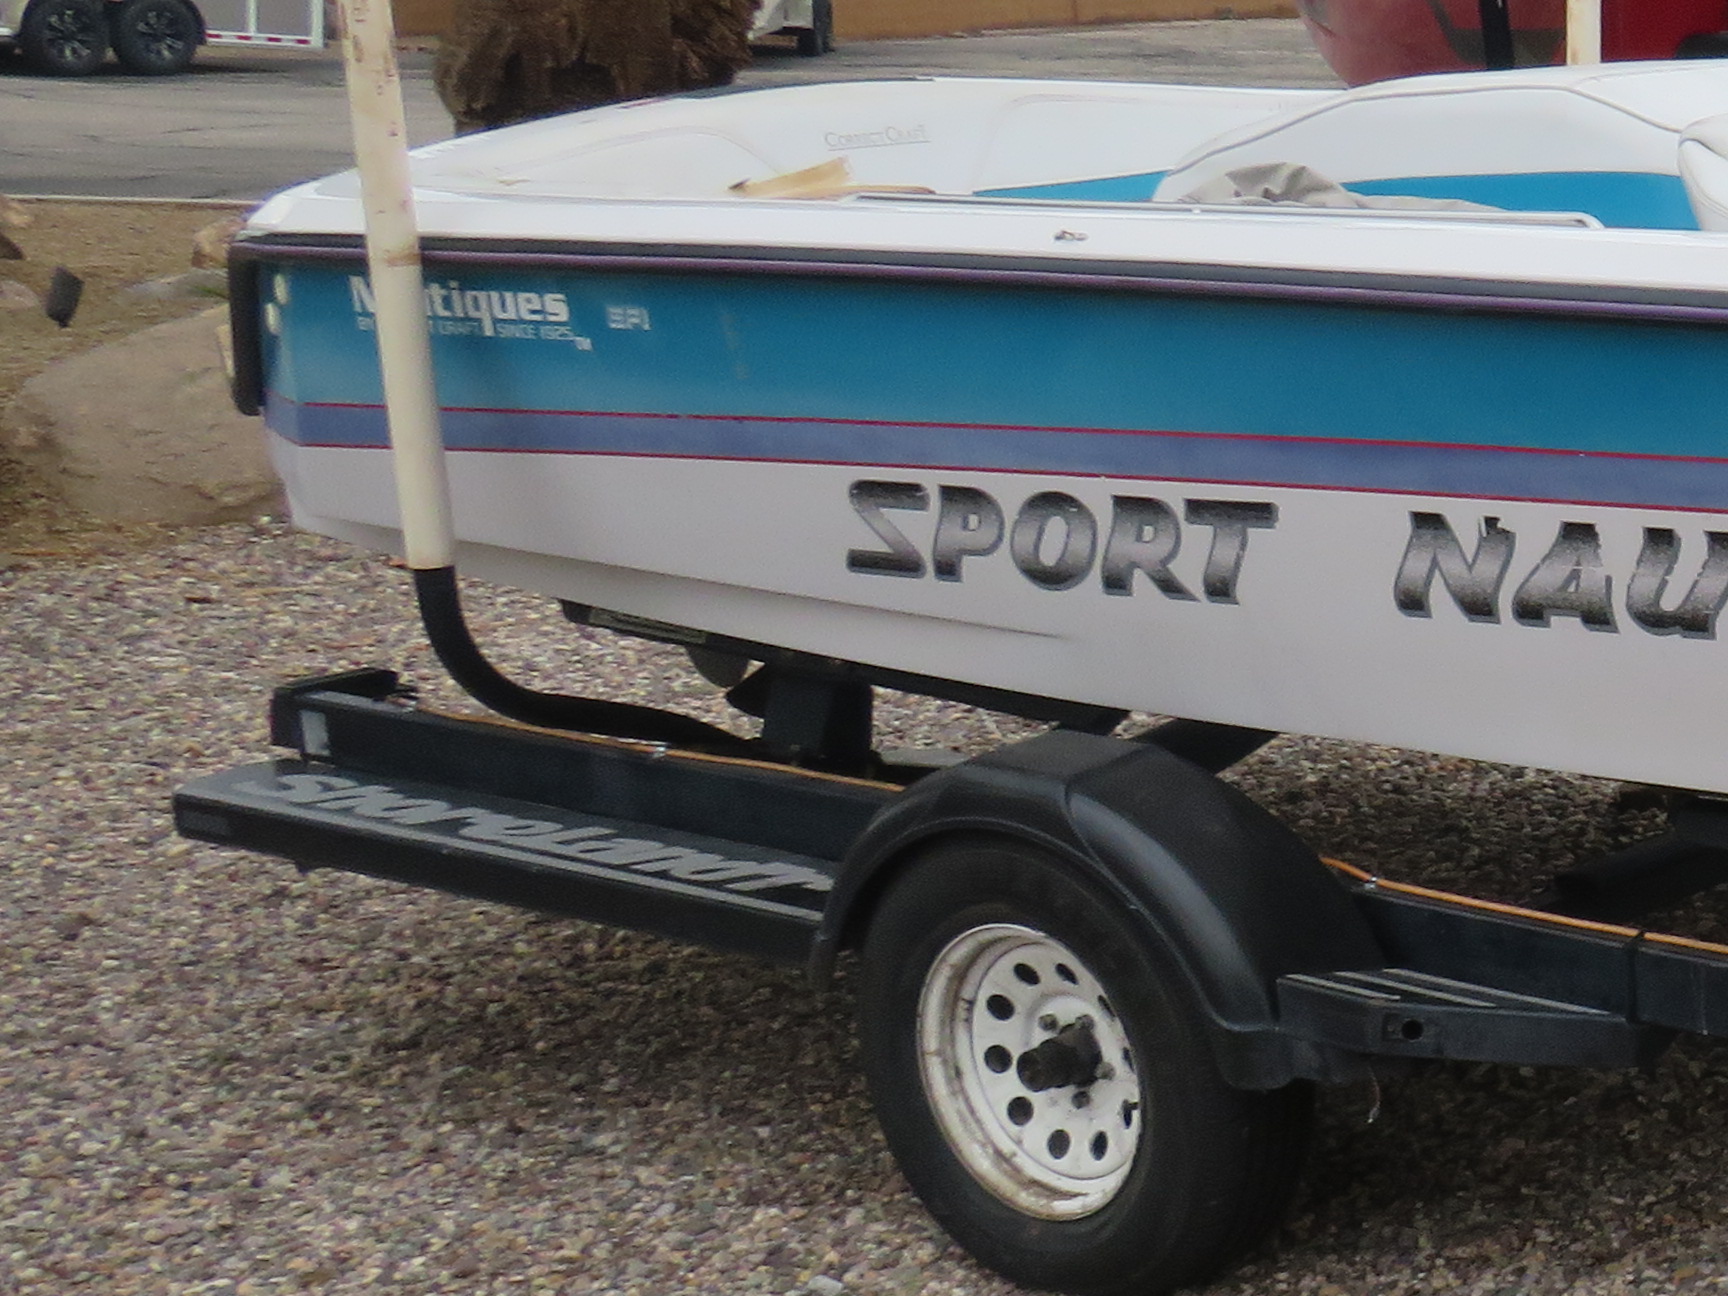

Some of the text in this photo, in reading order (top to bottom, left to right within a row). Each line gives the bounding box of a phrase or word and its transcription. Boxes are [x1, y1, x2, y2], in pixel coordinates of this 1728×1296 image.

[349, 274, 570, 337] Ntiques
[499, 323, 537, 339] SINCE
[846, 479, 1280, 606] SPORT
